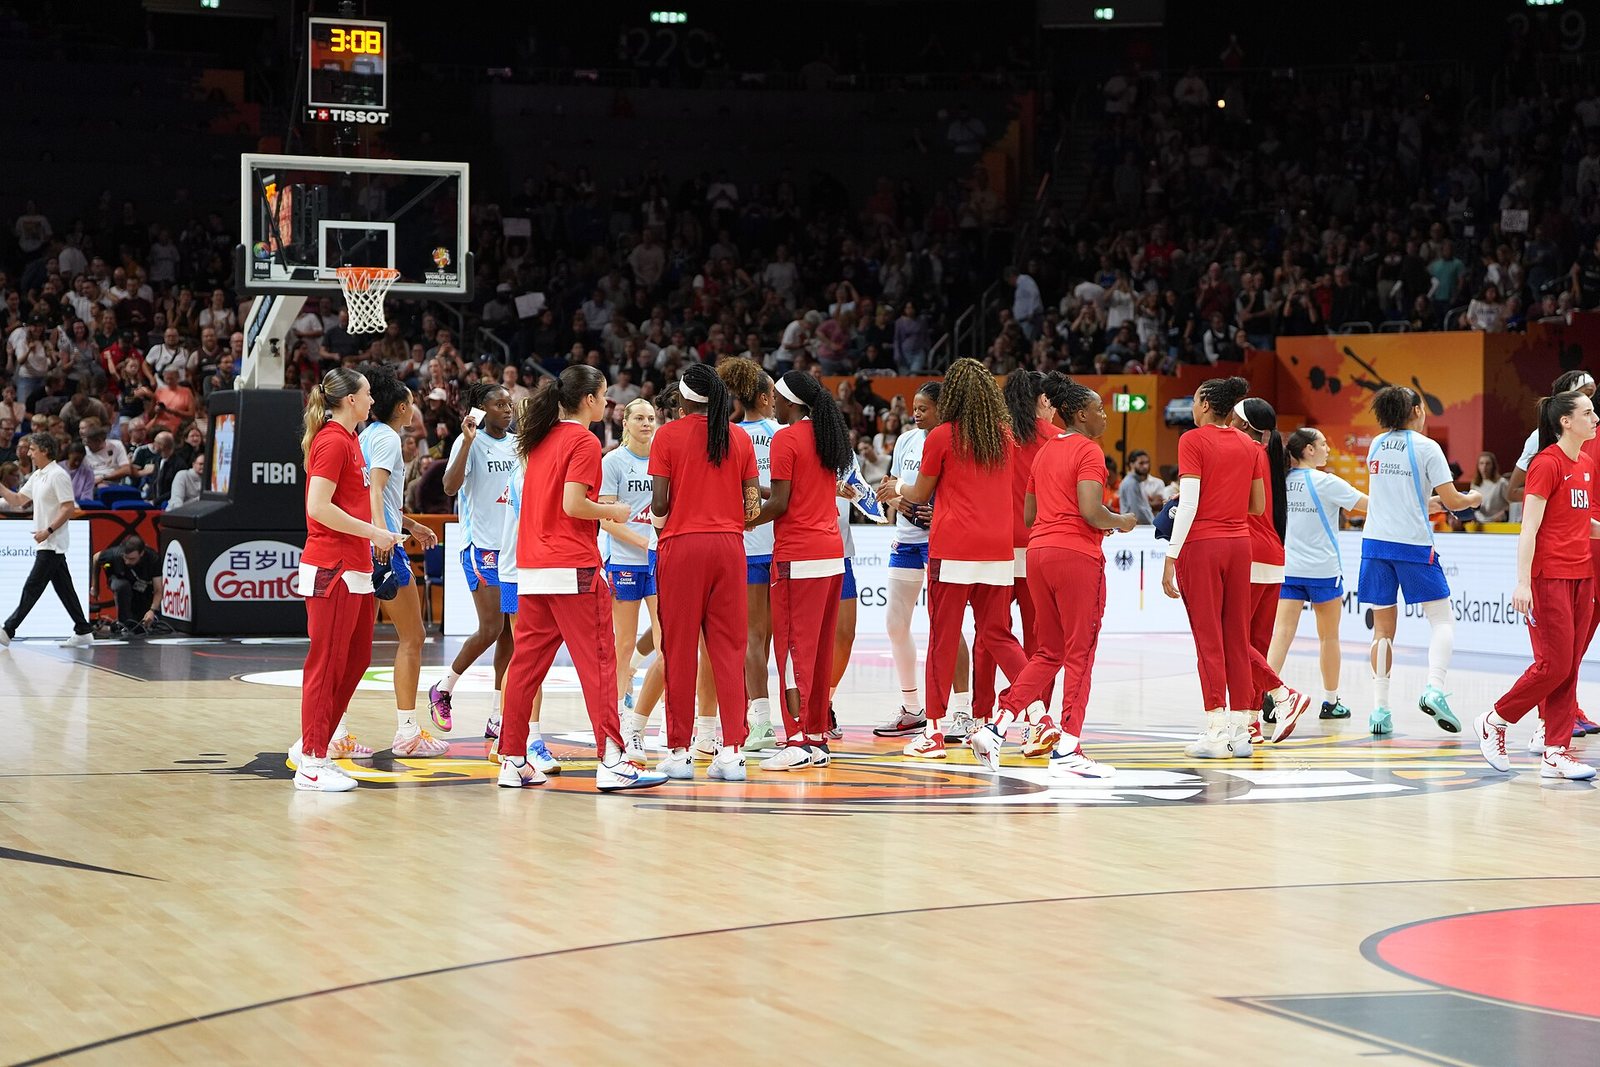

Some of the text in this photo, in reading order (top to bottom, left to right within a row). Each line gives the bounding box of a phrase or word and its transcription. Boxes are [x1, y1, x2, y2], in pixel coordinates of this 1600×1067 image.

[331, 28, 381, 54] 3:08
[330, 109, 390, 125] TISSOT
[252, 462, 296, 484] FIBA
[1571, 488, 1588, 508] USA
[229, 550, 302, 571] 百岁山
